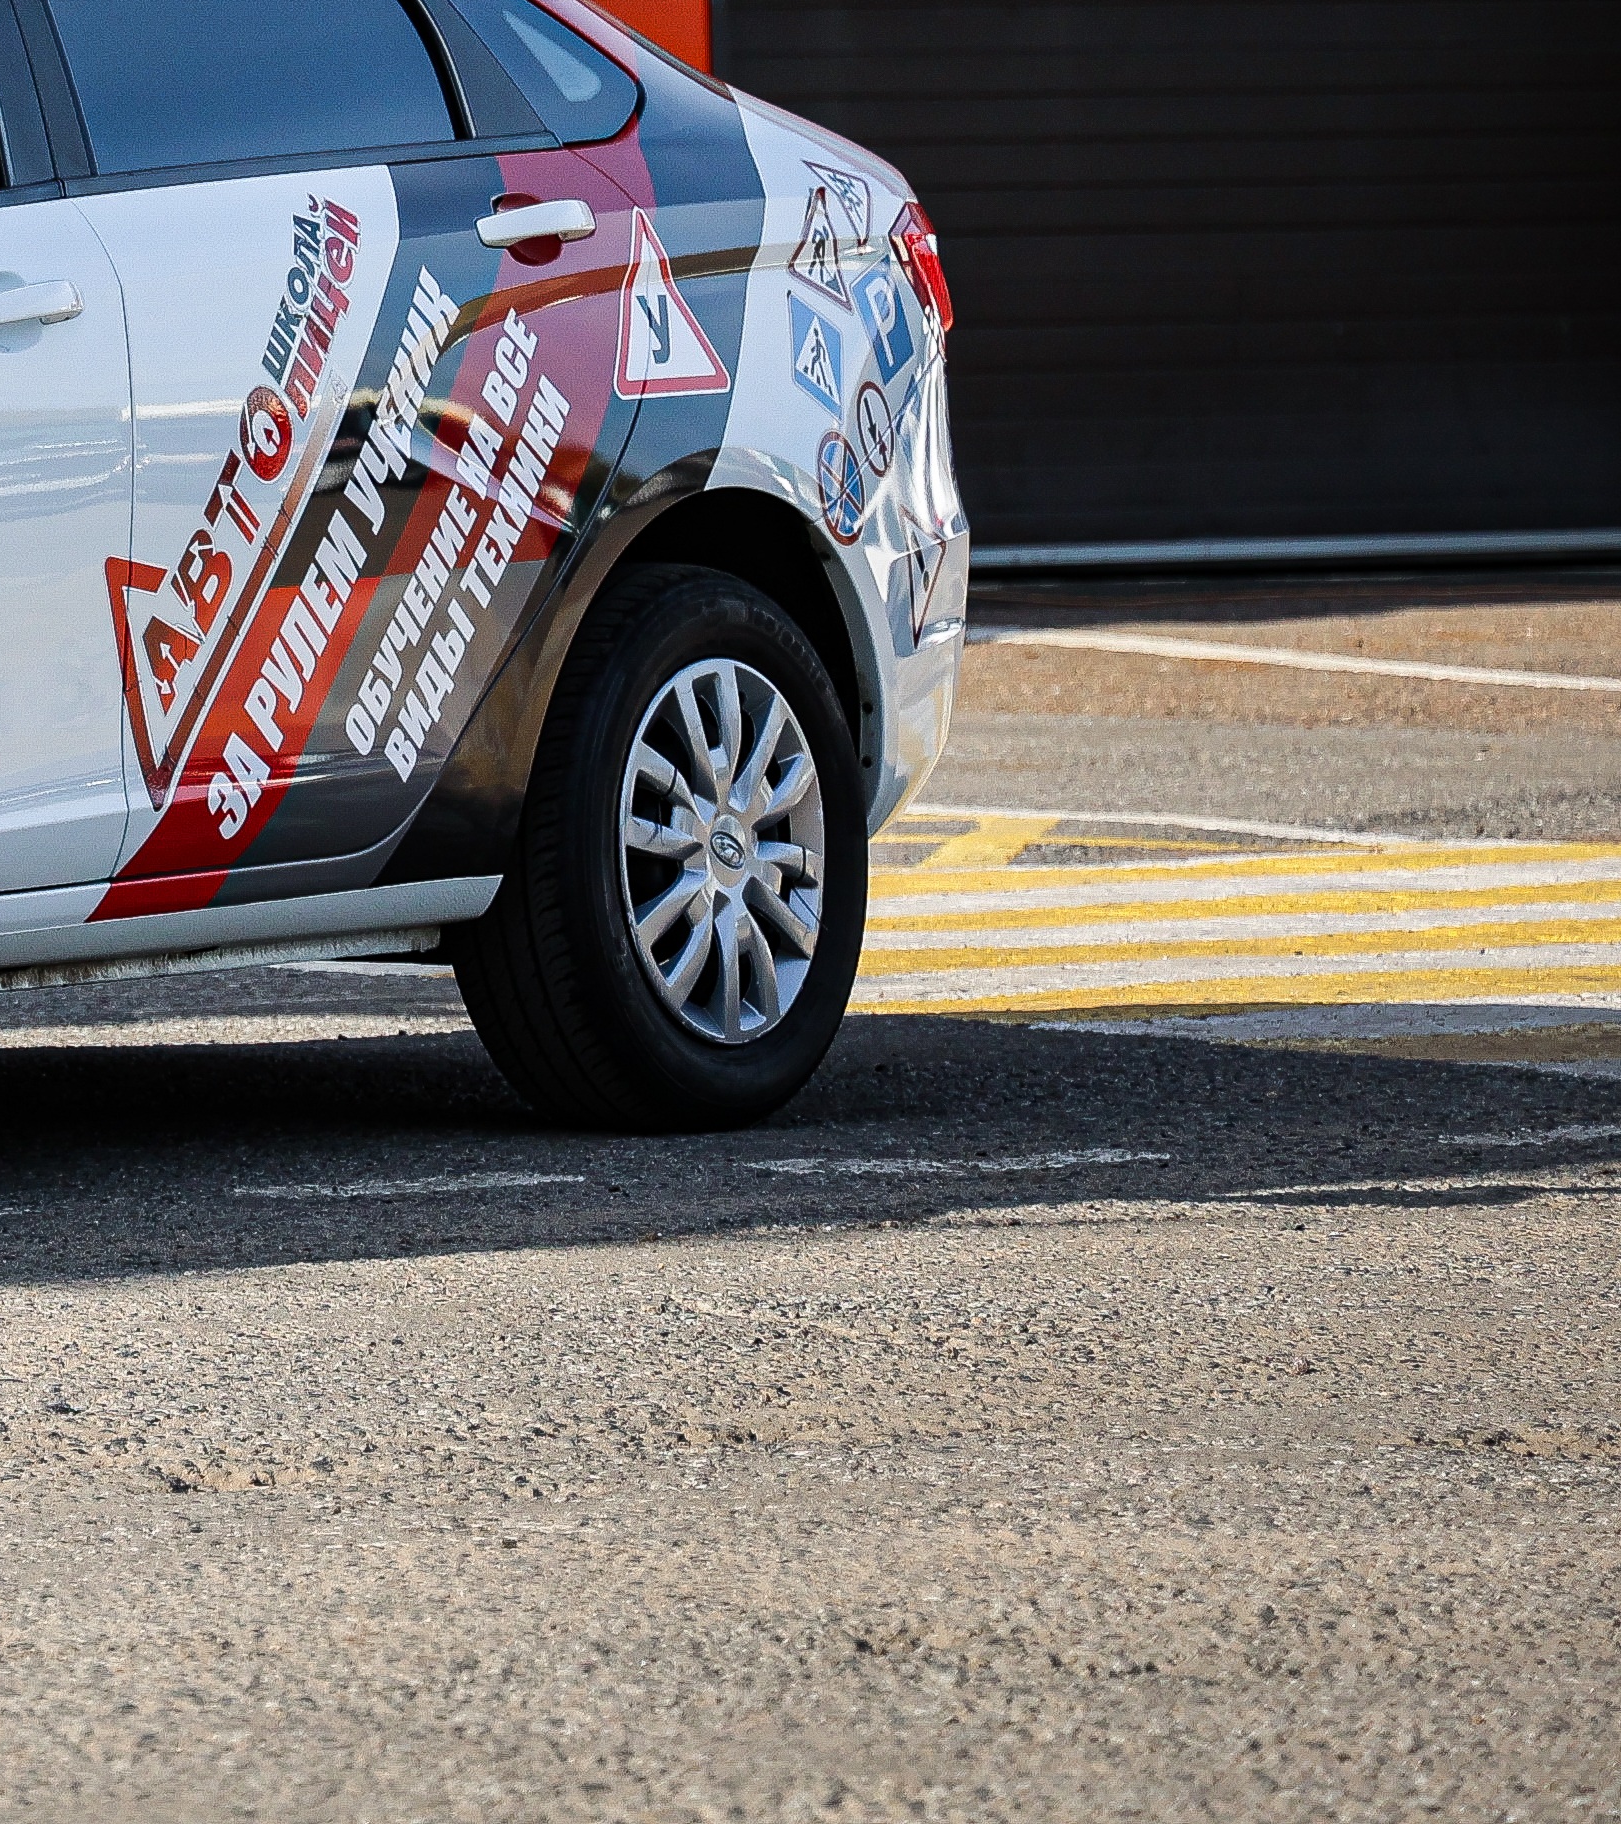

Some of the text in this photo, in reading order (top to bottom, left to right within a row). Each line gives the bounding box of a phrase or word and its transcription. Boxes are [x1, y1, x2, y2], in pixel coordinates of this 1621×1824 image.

[263, 210, 321, 383] ШКОЛА
[206, 265, 460, 840] ЗА РУЛЕМ УЧЕНИК
[344, 307, 539, 757] ОБУЧЕНИЕ НА ВСЕ
[383, 374, 572, 783] ВИДЫ ТЕХНИКИ
